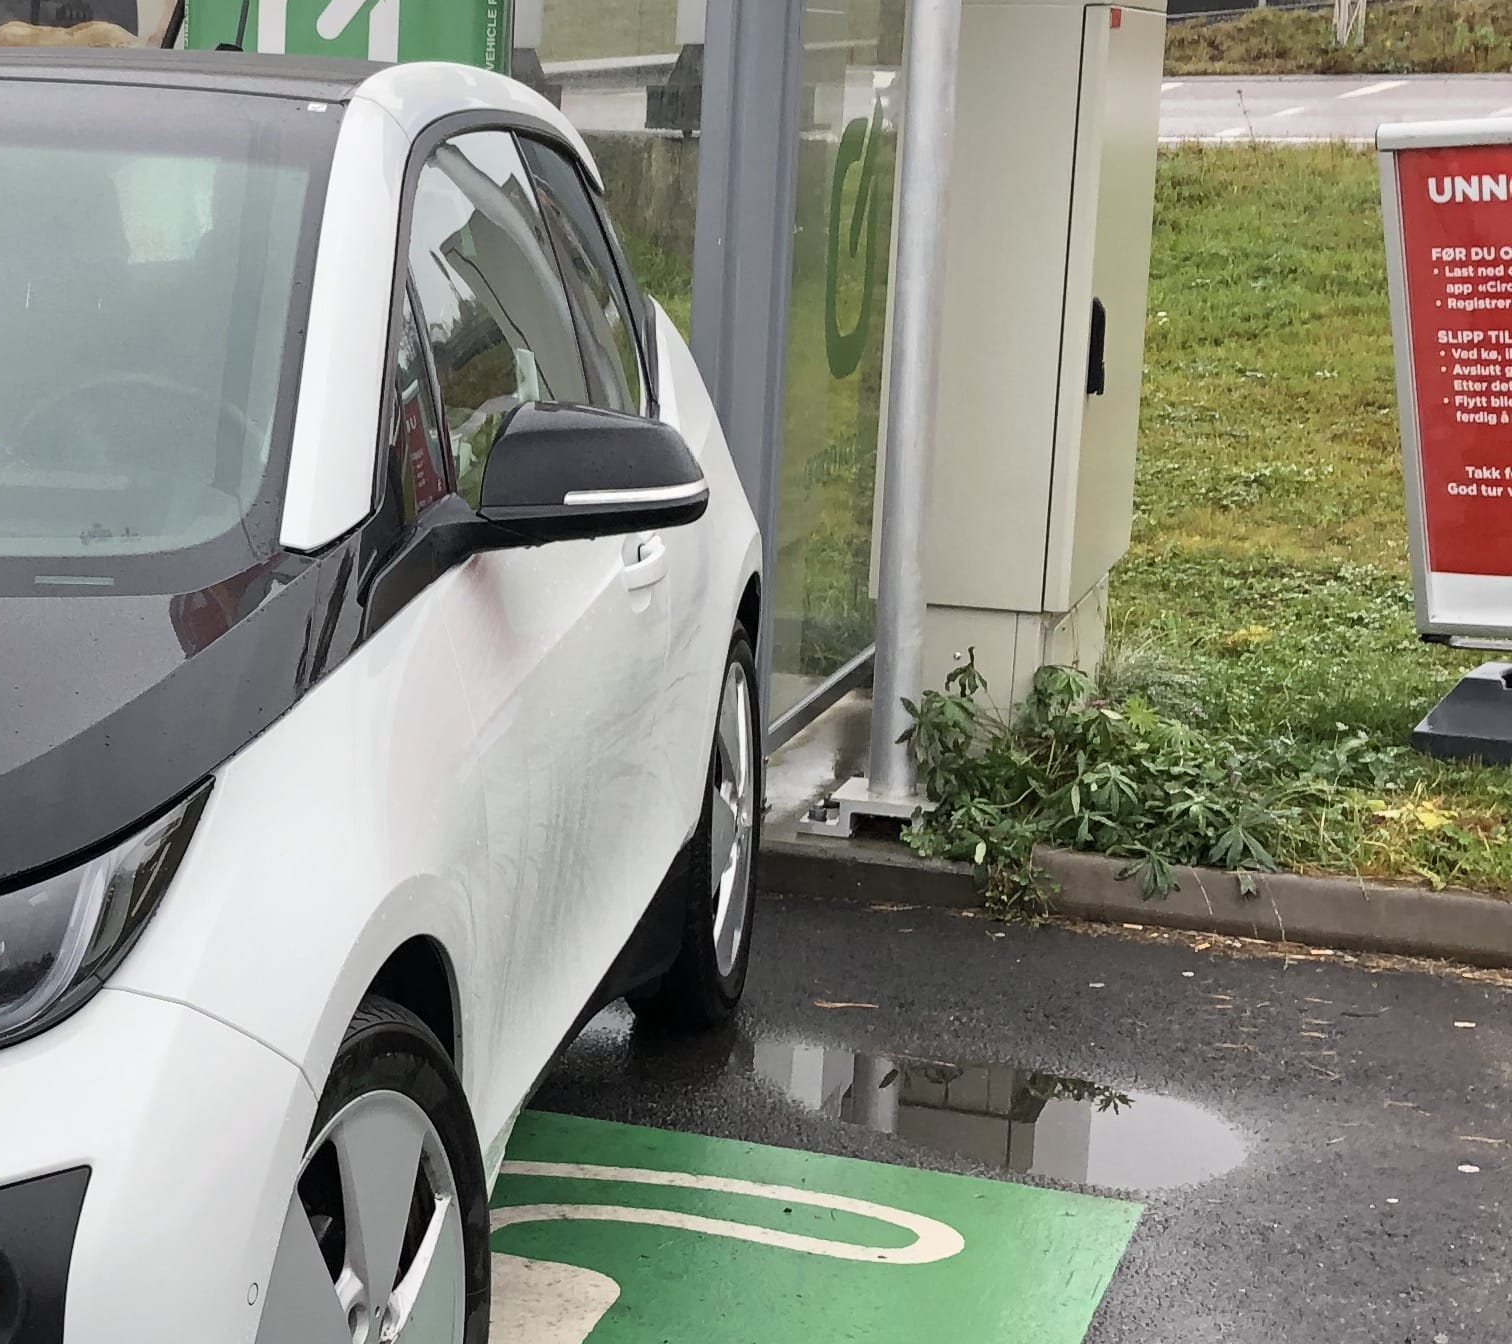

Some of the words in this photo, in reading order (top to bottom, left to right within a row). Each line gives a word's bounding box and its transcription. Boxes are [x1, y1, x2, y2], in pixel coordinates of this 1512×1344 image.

[485, 10, 498, 71] VEHICLE
[1428, 174, 1512, 203] UNN
[1432, 247, 1467, 261] FØR
[1471, 246, 1496, 261] DU
[1445, 265, 1474, 277] Last
[1477, 264, 1505, 277] ned
[1446, 282, 1473, 296] app
[1447, 297, 1512, 312] Registrer
[1437, 330, 1484, 344] SLIPP
[1451, 348, 1478, 360] Ved
[1453, 364, 1501, 376] Avslutt
[1453, 380, 1488, 392] Etter
[1455, 395, 1487, 408] Flytt
[1456, 411, 1497, 425] ferdig
[1500, 410, 1510, 424] å
[1465, 466, 1501, 480] Takk
[1447, 482, 1478, 496] God
[1481, 483, 1504, 497] tur
